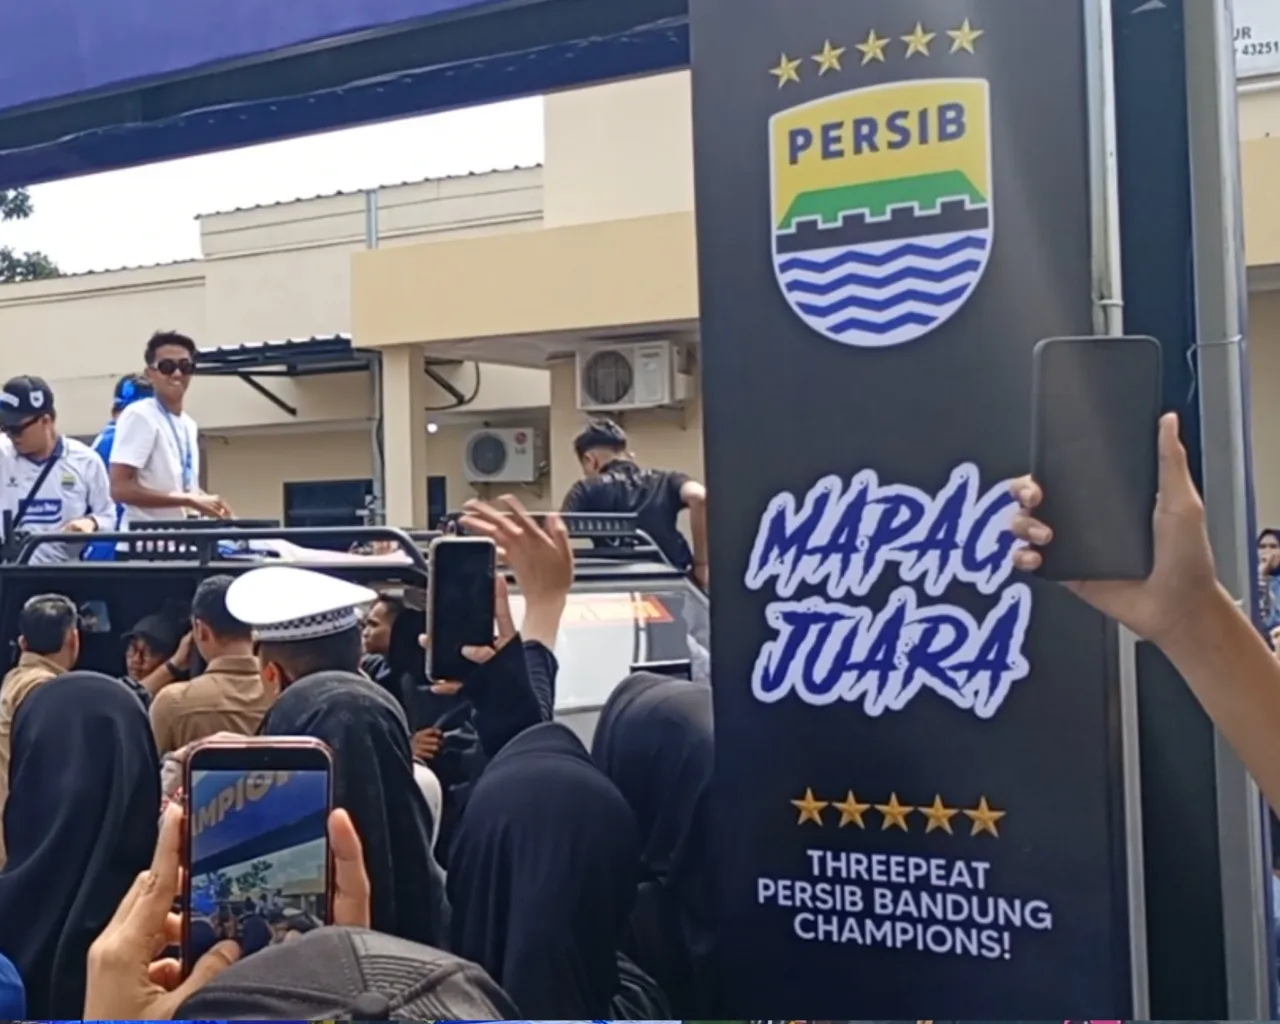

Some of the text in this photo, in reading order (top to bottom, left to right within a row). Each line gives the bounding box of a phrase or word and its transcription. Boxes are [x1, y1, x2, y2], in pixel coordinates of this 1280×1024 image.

[787, 102, 967, 167] PERSIB
[744, 462, 1023, 599] MAPAG
[751, 583, 1032, 719] JUARA
[806, 848, 991, 890] THREEPEAT
[757, 877, 1053, 931] PERSIB BANDUNG
[793, 912, 1012, 960] CHAMPIONS!
